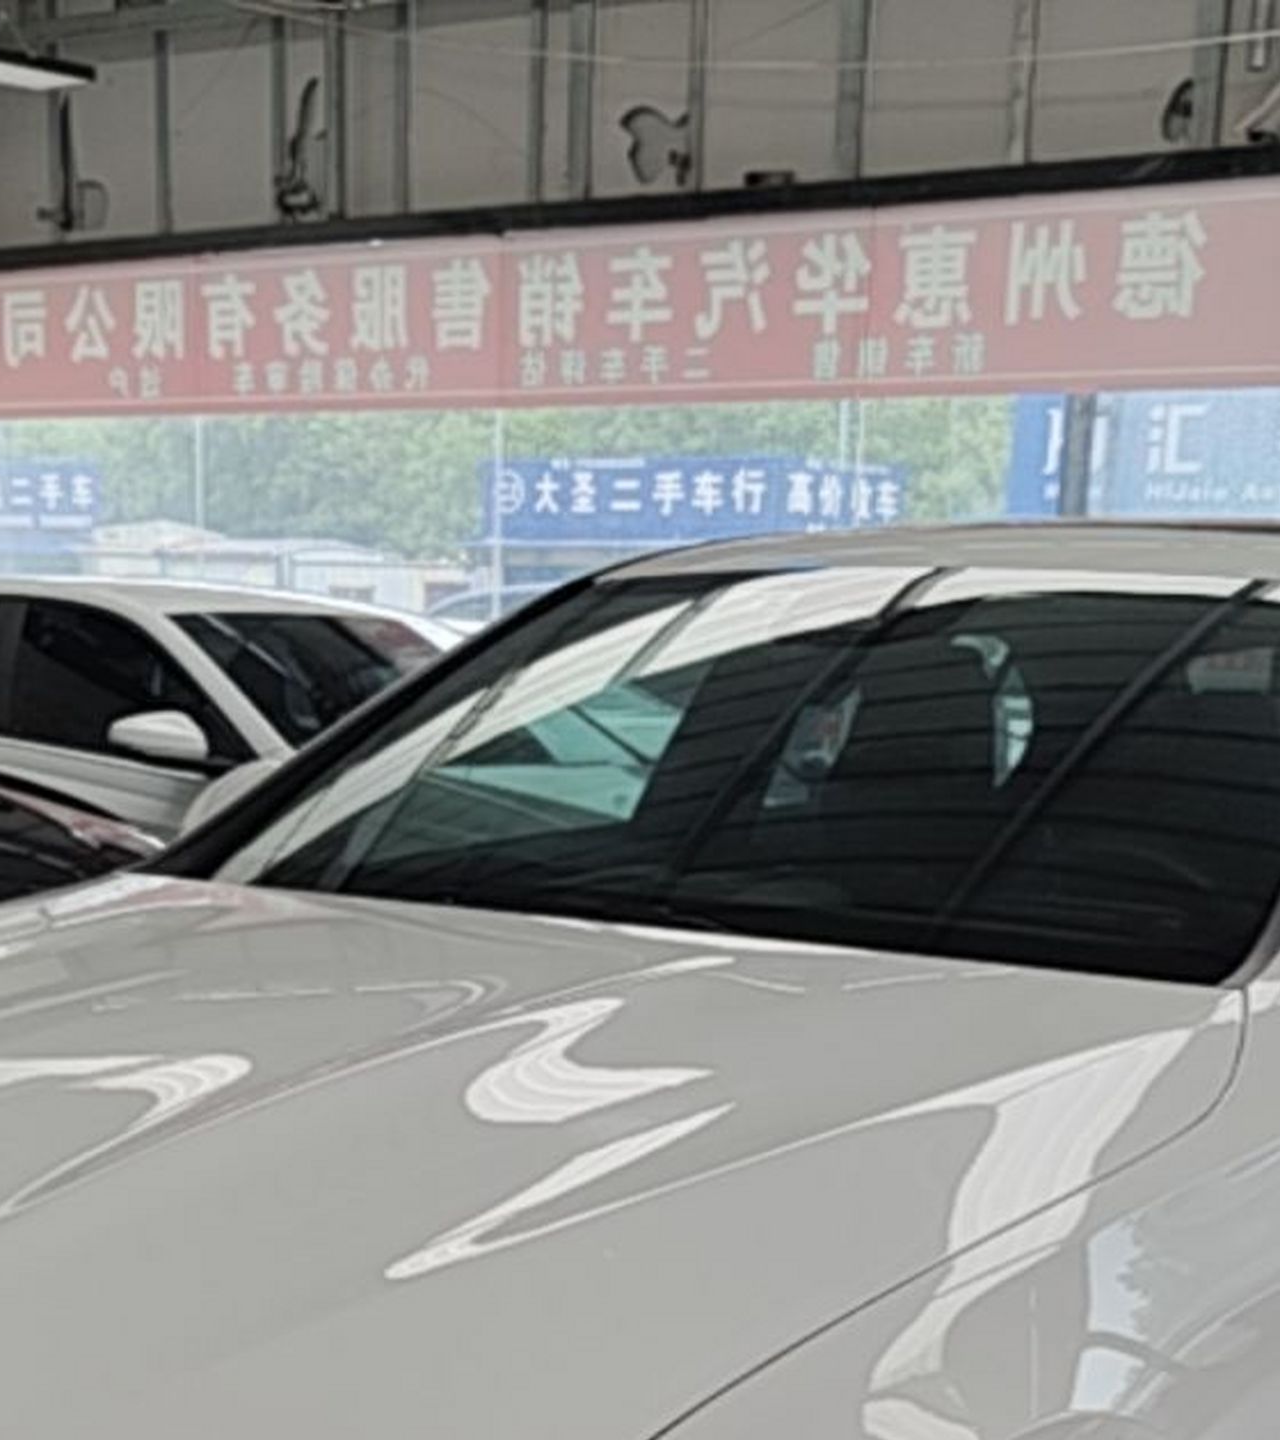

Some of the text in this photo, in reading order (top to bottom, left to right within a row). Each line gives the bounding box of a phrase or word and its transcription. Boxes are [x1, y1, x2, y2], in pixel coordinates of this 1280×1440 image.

[534, 467, 767, 517] 大圣二手车行
